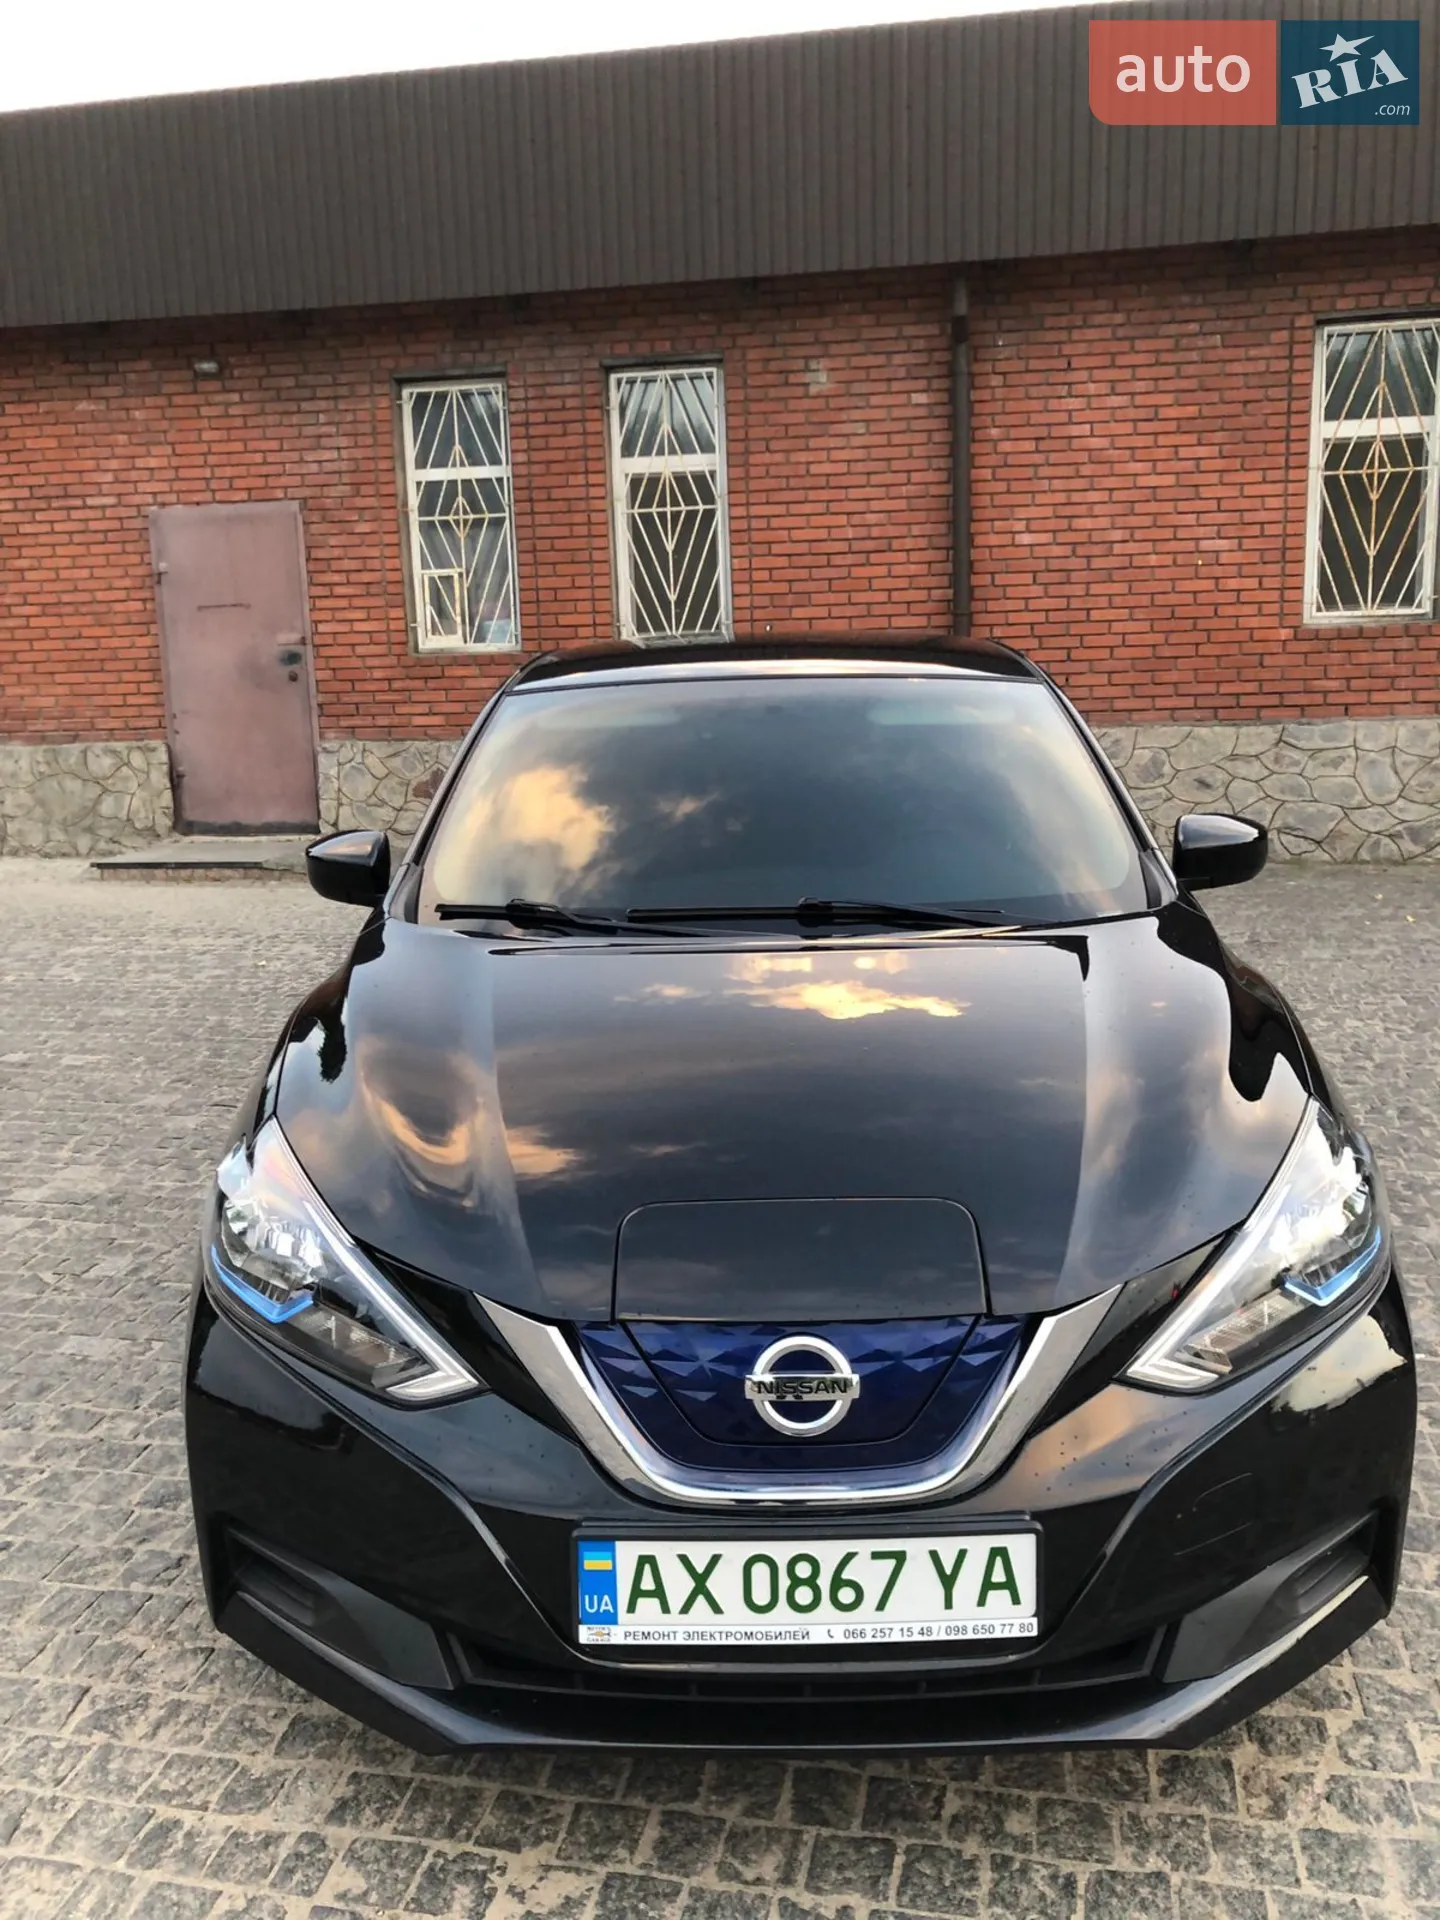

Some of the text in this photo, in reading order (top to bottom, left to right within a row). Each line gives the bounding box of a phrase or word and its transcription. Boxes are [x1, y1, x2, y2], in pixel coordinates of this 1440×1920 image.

[757, 1380, 848, 1394] NISSAN
[625, 1545, 1022, 1615] AX 0867 YA
[584, 1594, 614, 1614] UA
[623, 1630, 679, 1641] РЕМОНТ
[682, 1628, 811, 1641] ЭЛЕКТРОМОБИЛЕЙ
[843, 1628, 867, 1640] 066
[871, 1627, 894, 1639] 257
[899, 1626, 914, 1638] 15
[917, 1625, 933, 1637] 48
[945, 1624, 968, 1637] 098
[972, 1624, 995, 1635] 650
[999, 1623, 1015, 1634] 77
[1018, 1622, 1034, 1633] 80
